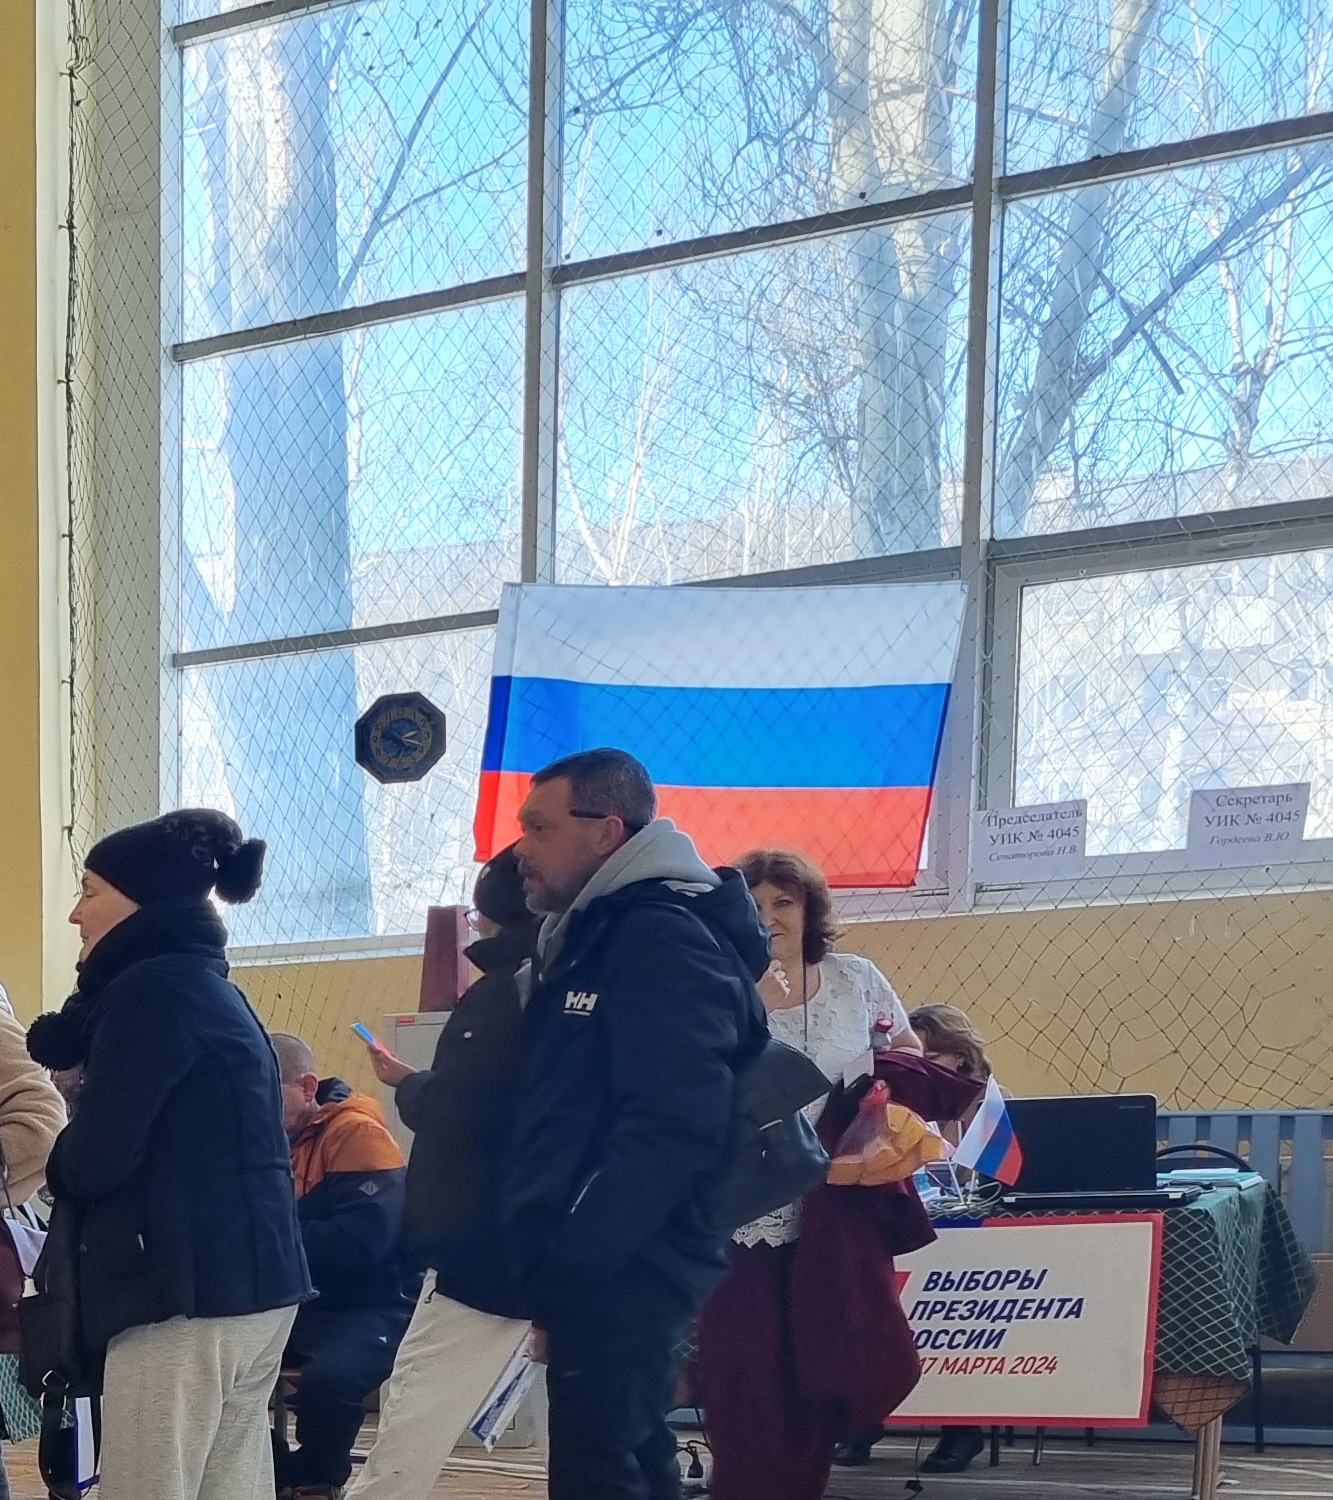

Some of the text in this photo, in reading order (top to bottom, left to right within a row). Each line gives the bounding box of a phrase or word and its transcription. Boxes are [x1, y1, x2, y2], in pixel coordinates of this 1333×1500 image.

[1215, 794, 1293, 808] Секретарь
[987, 810, 1083, 829] Председатель
[1205, 810, 1301, 828] УИК № 4045
[989, 826, 1080, 846] УИК № 4045
[1209, 836, 1261, 847] Гордеева
[989, 850, 1054, 862] Сенаторова
[923, 1268, 1048, 1292] ВЫБОРЫ
[908, 1297, 1085, 1324] ПРЕЗИДЕНТА
[939, 1356, 1006, 1375] МАРТА
[1009, 1356, 1058, 1375] 2024
